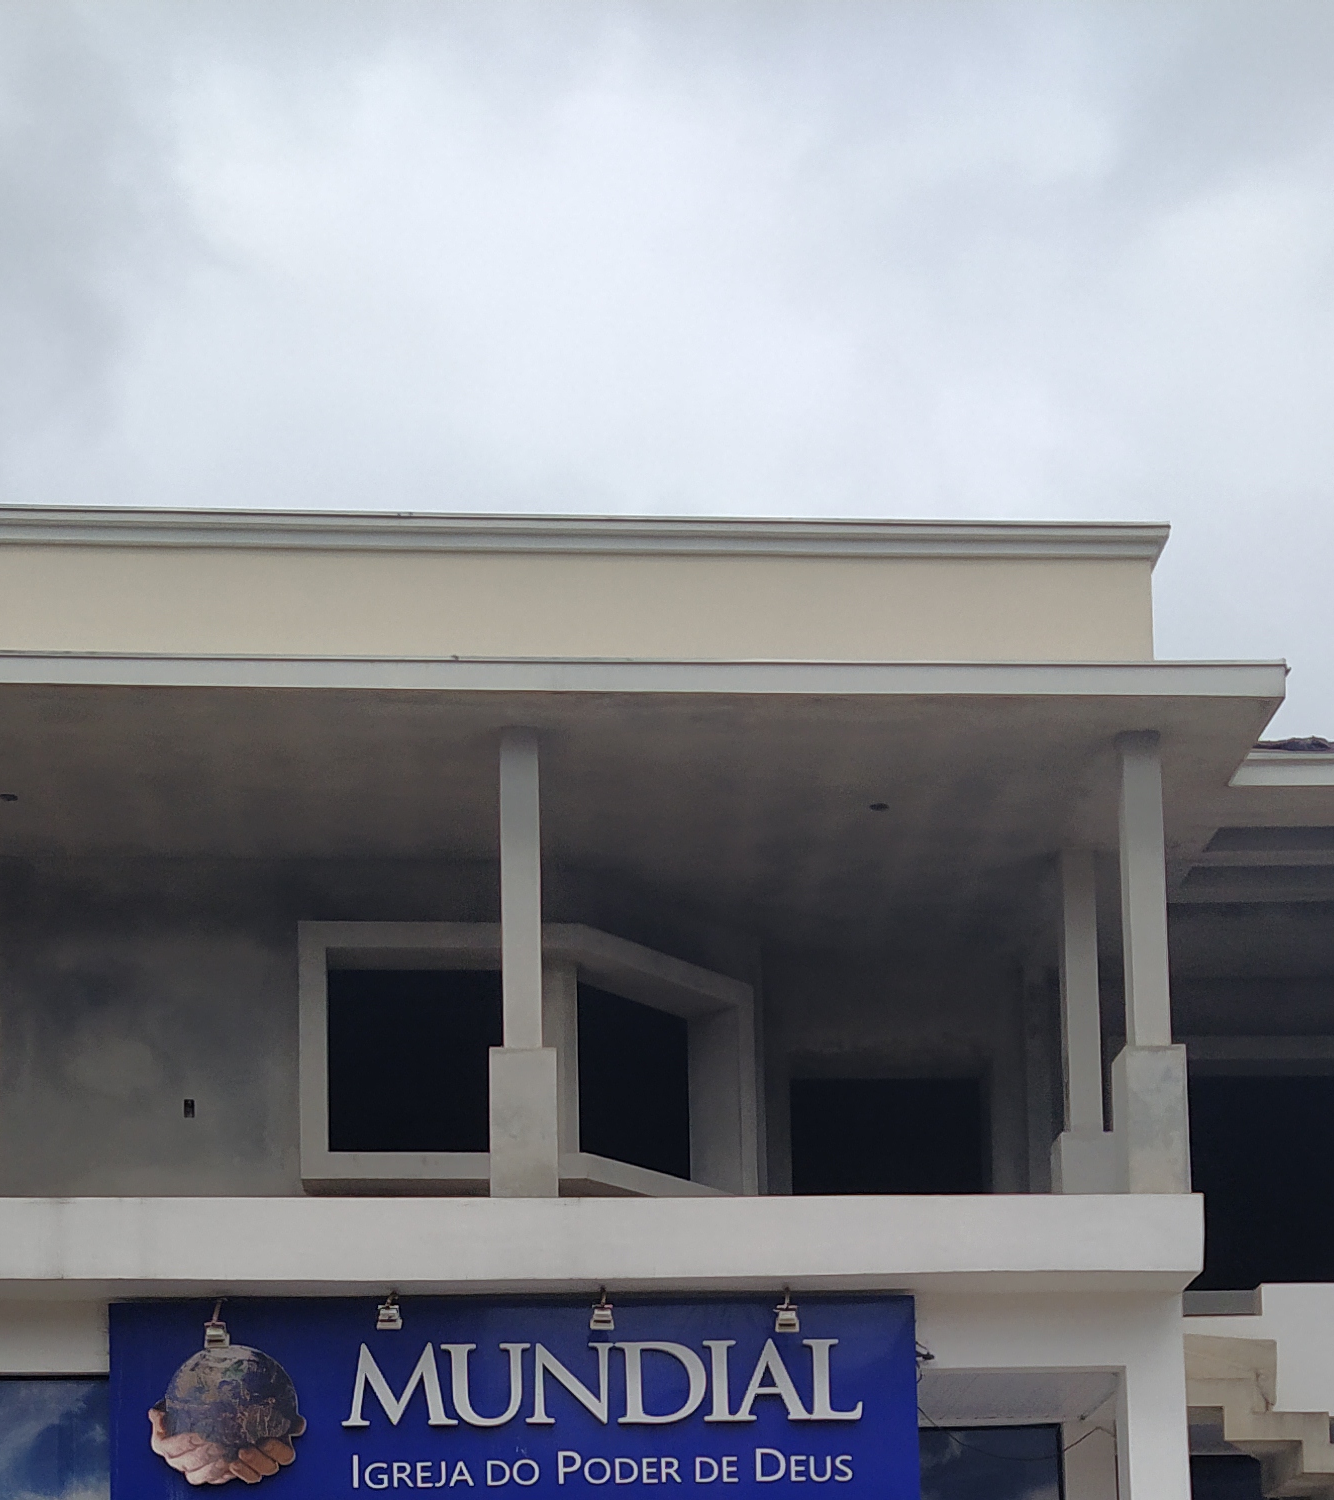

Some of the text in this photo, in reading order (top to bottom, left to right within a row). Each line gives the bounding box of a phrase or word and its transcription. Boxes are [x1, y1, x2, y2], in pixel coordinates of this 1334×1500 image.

[341, 1337, 863, 1428] MUNDIAL
[351, 1453, 475, 1489] IGREJA
[557, 1450, 683, 1486] PODER
[755, 1447, 854, 1483] DEUS
